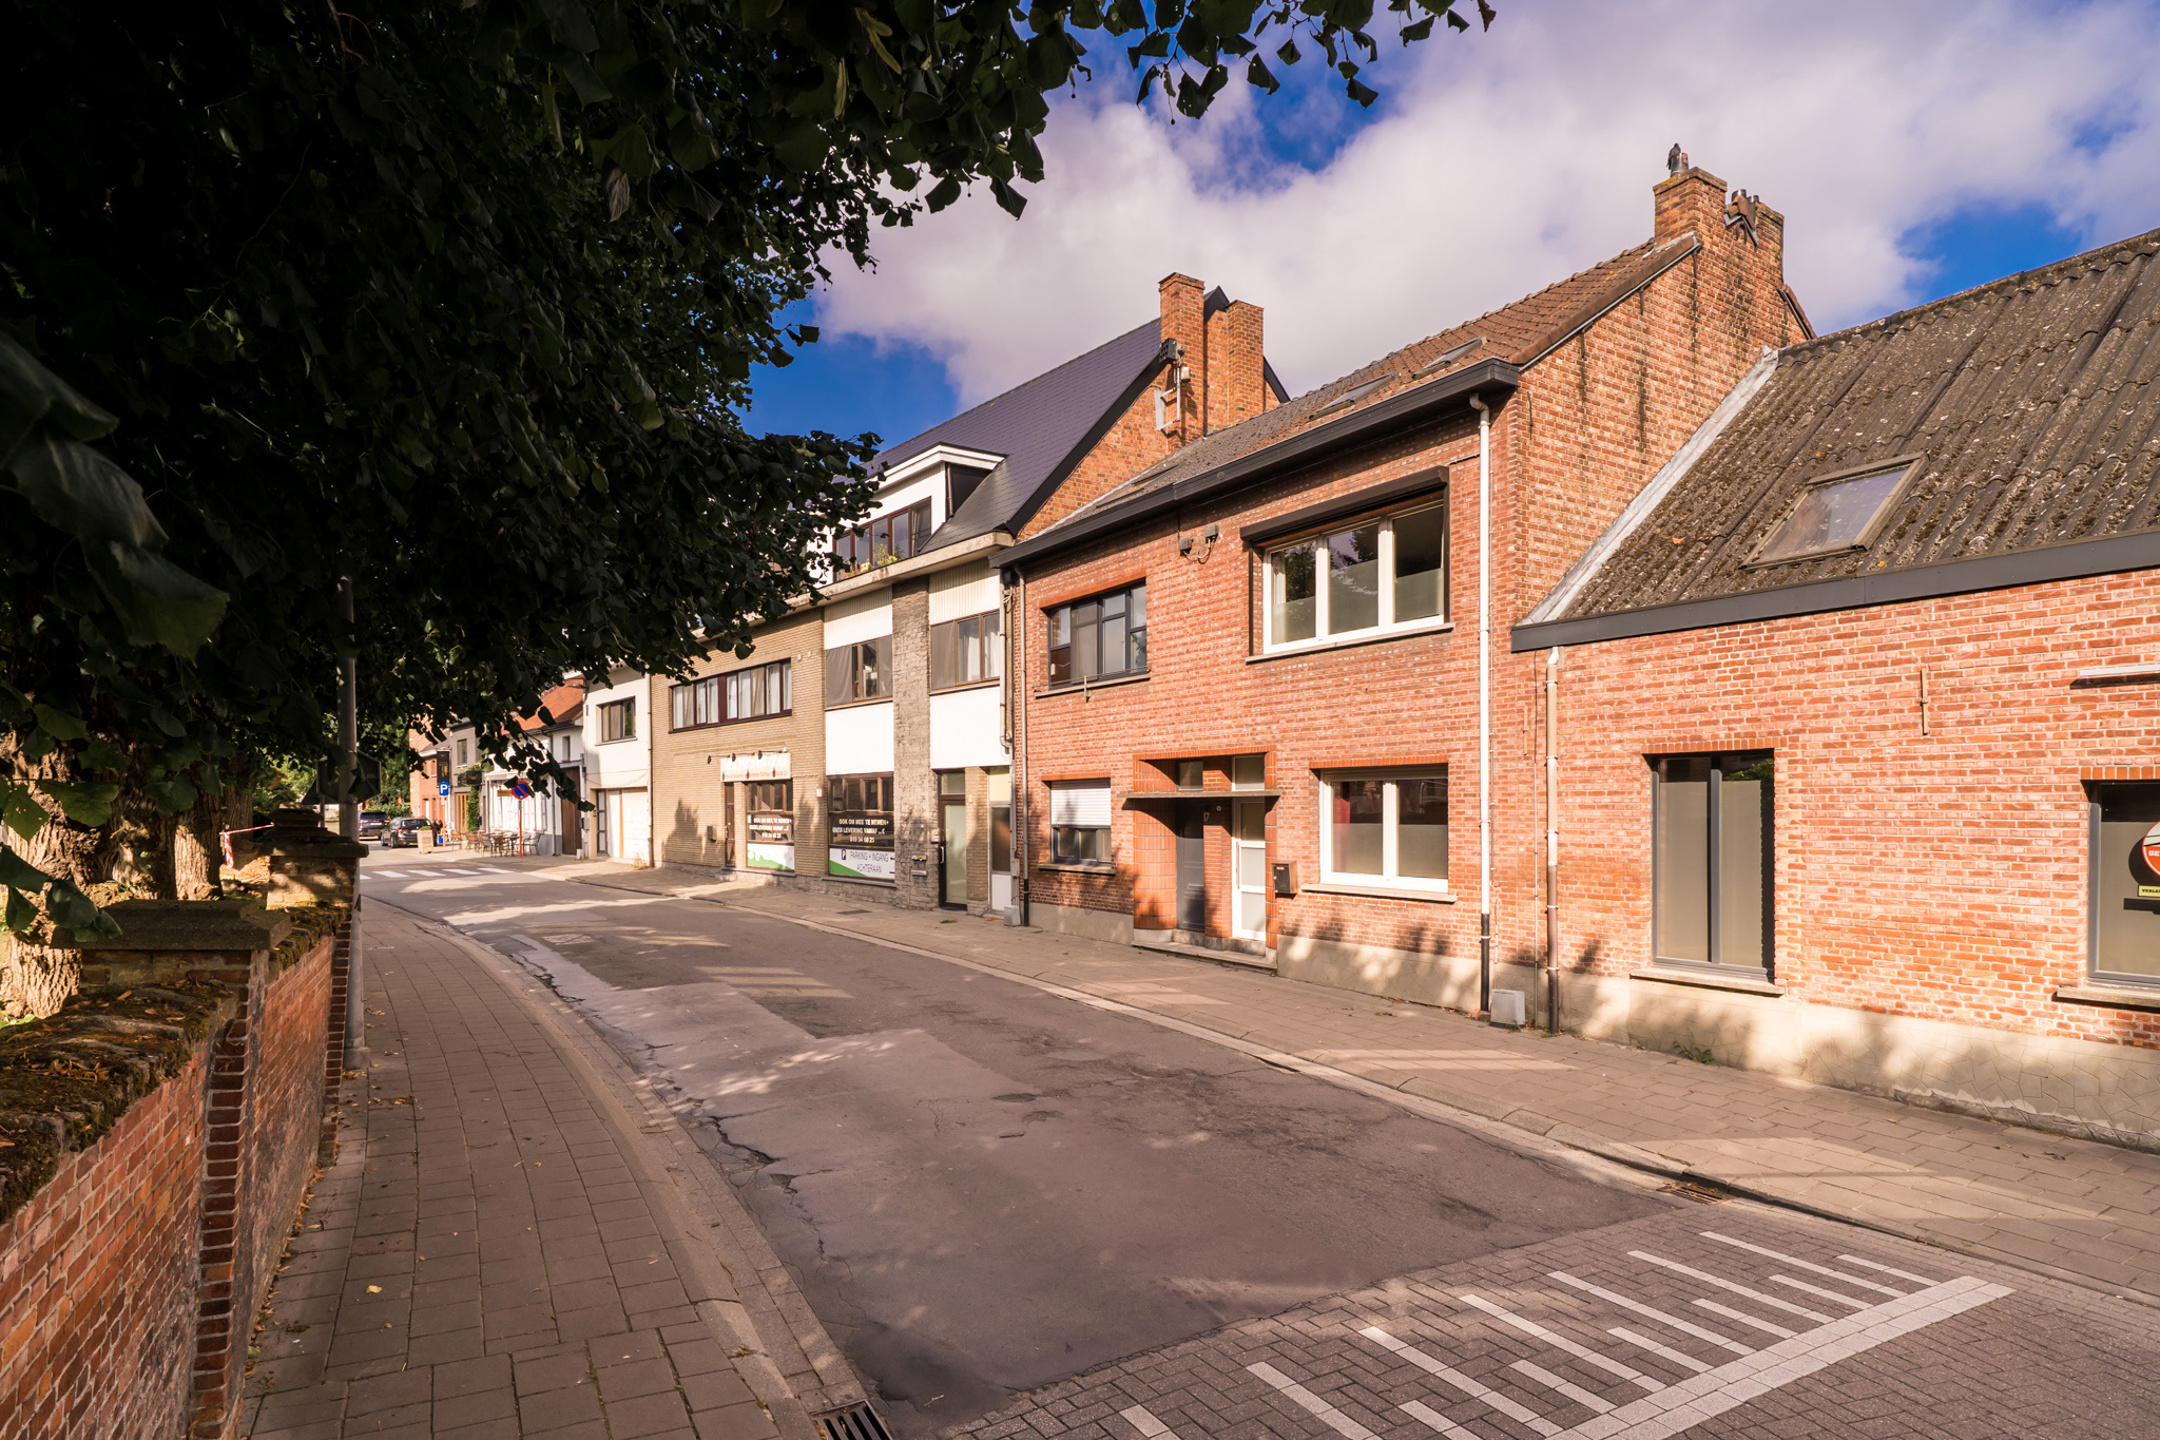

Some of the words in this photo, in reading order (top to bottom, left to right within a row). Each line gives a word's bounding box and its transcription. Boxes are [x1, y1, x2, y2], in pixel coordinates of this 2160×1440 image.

[441, 785, 448, 794] P
[850, 851, 868, 860] PARKING
[872, 853, 888, 862] INGANG
[857, 864, 882, 873] ACHTERAAN
